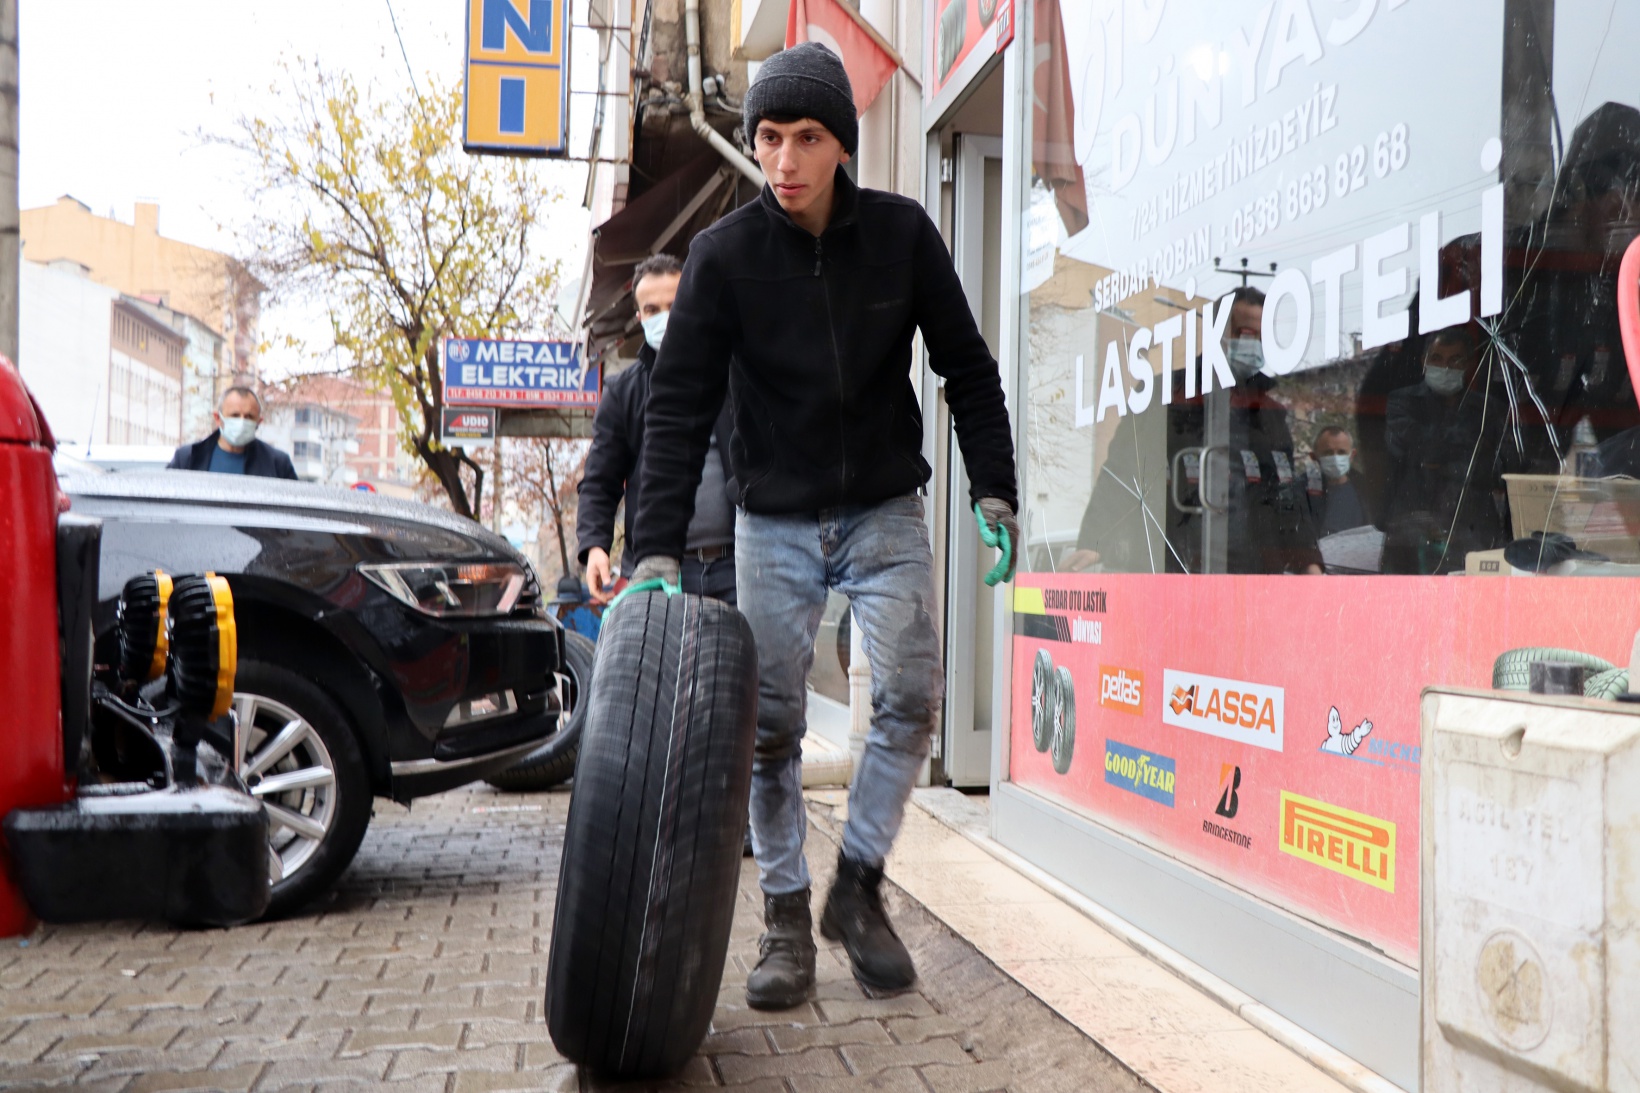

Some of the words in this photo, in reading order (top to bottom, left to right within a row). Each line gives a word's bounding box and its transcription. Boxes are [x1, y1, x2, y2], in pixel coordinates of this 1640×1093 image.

[1130, 201, 1158, 241] 7/24
[1162, 82, 1339, 222] HİZMETİNİZDEYİZ
[1094, 259, 1149, 314] SERDAR
[1151, 224, 1212, 289] ÇOBAN
[1231, 189, 1282, 247] 0538
[1285, 163, 1329, 222] 863
[1333, 144, 1368, 198] 82
[1372, 122, 1410, 179] 68
[1074, 275, 1237, 429] LASTİK
[1261, 137, 1504, 378] OTELİ
[476, 341, 570, 365] MERAL
[1044, 588, 1068, 609] SERDAR
[1069, 590, 1082, 611] OTO
[1083, 587, 1107, 613] LASTİK
[1073, 615, 1102, 645] DÜNYASI
[1101, 670, 1141, 705] petlas
[1192, 685, 1276, 734] LASSA
[1203, 819, 1252, 850] BRIDGESTONE
[1284, 798, 1390, 881] PIRELLI
